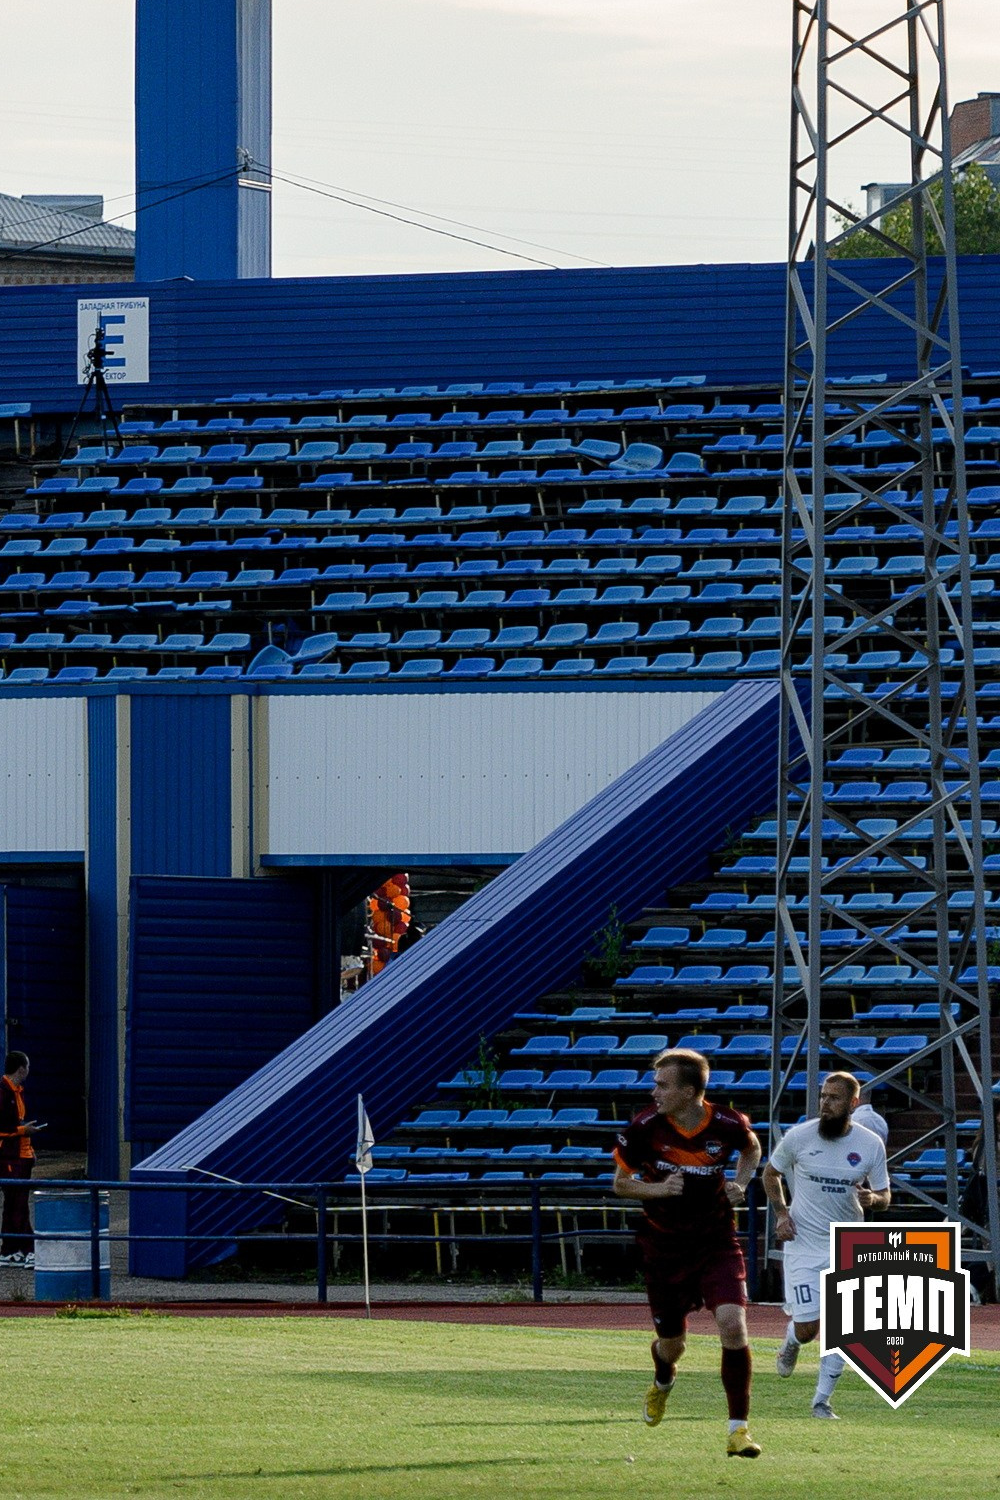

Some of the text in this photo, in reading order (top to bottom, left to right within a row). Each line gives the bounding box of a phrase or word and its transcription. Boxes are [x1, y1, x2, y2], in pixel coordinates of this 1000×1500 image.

[80, 301, 147, 311] ЗАПАДНАЯ ТРИБУНА
[105, 372, 127, 380] ЕКТОР
[793, 1284, 813, 1305] 10
